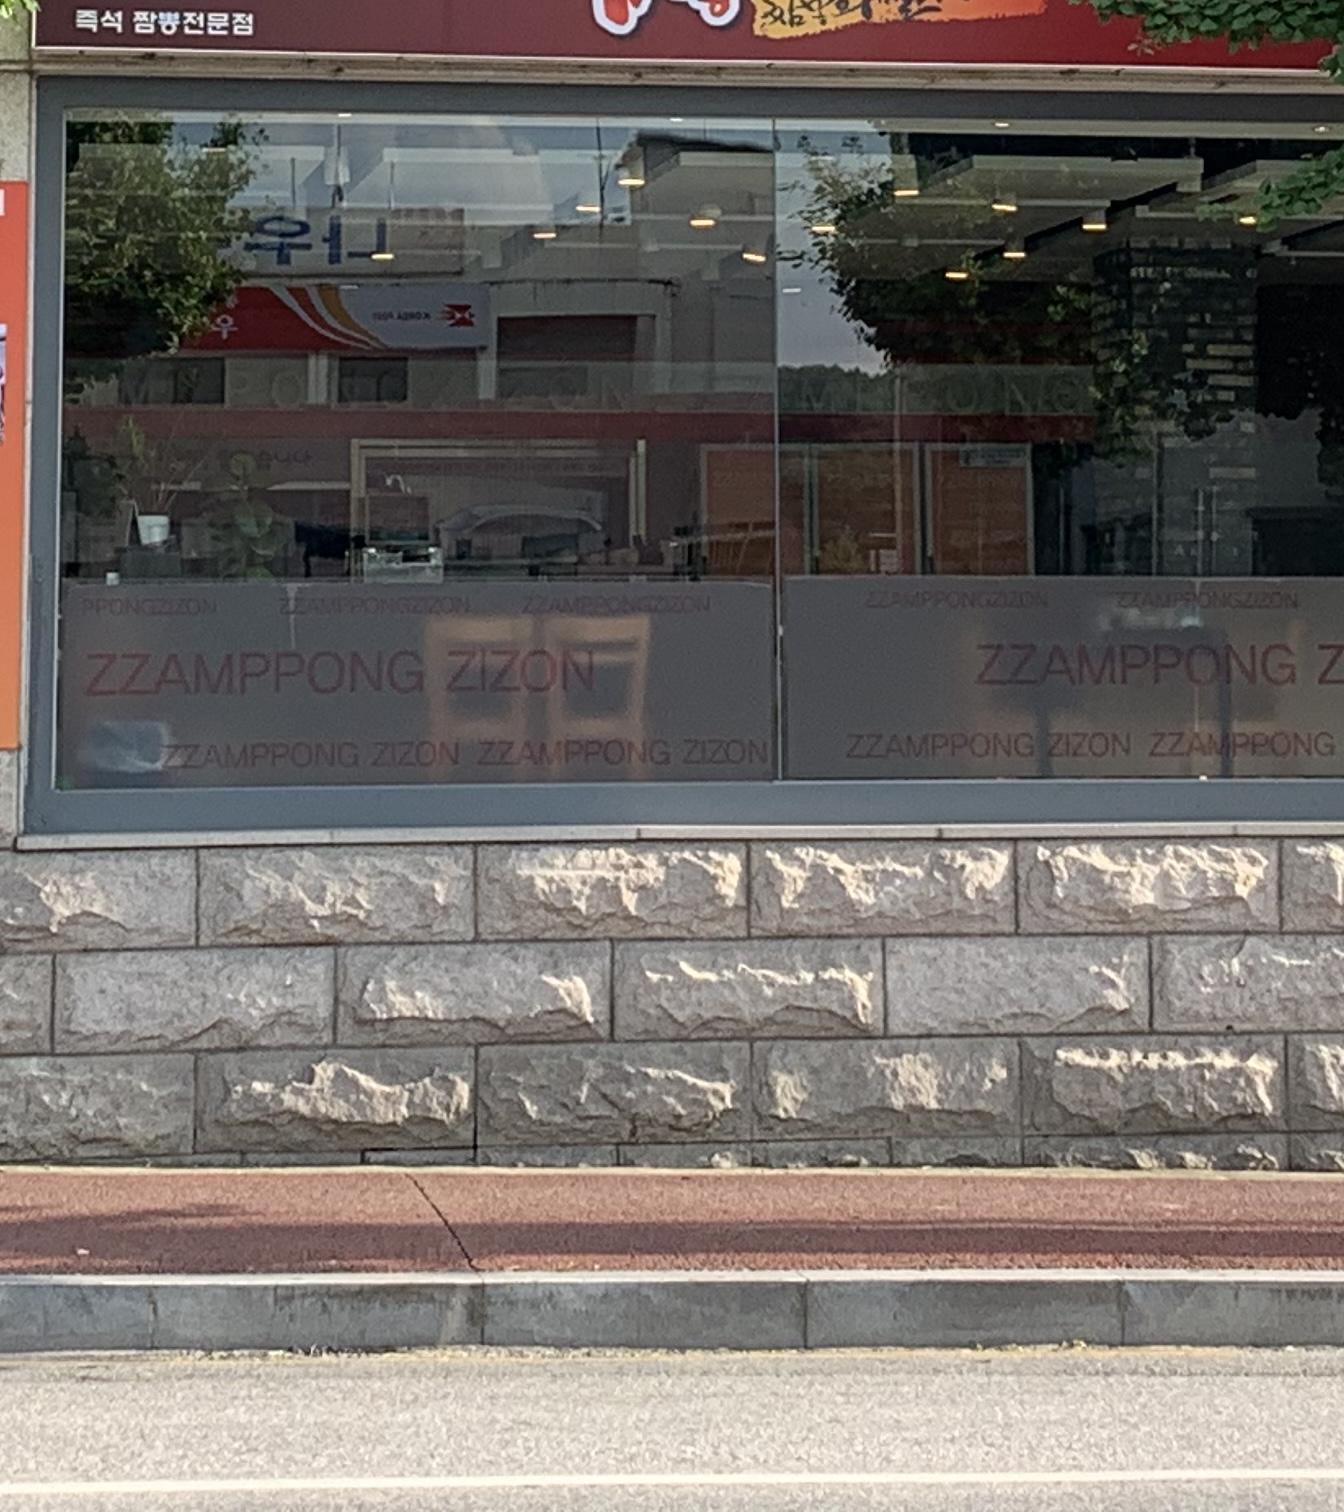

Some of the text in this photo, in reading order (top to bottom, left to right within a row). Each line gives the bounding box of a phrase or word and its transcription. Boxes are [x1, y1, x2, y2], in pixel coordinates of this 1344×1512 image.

[74, 8, 255, 37] 즉석 짬뽕전문점
[84, 648, 596, 697] ZZAMPPONG ZIZON
[974, 644, 1297, 686] ZZAMPPONG
[160, 742, 360, 771] ZZAMPPONG
[371, 741, 460, 768] ZIZON
[476, 739, 671, 767] ZZAMPPONG
[845, 733, 1035, 760] ZZAMPPONG
[1046, 732, 1132, 757] ZIZON
[1147, 732, 1335, 758] ZZAMPPONG
